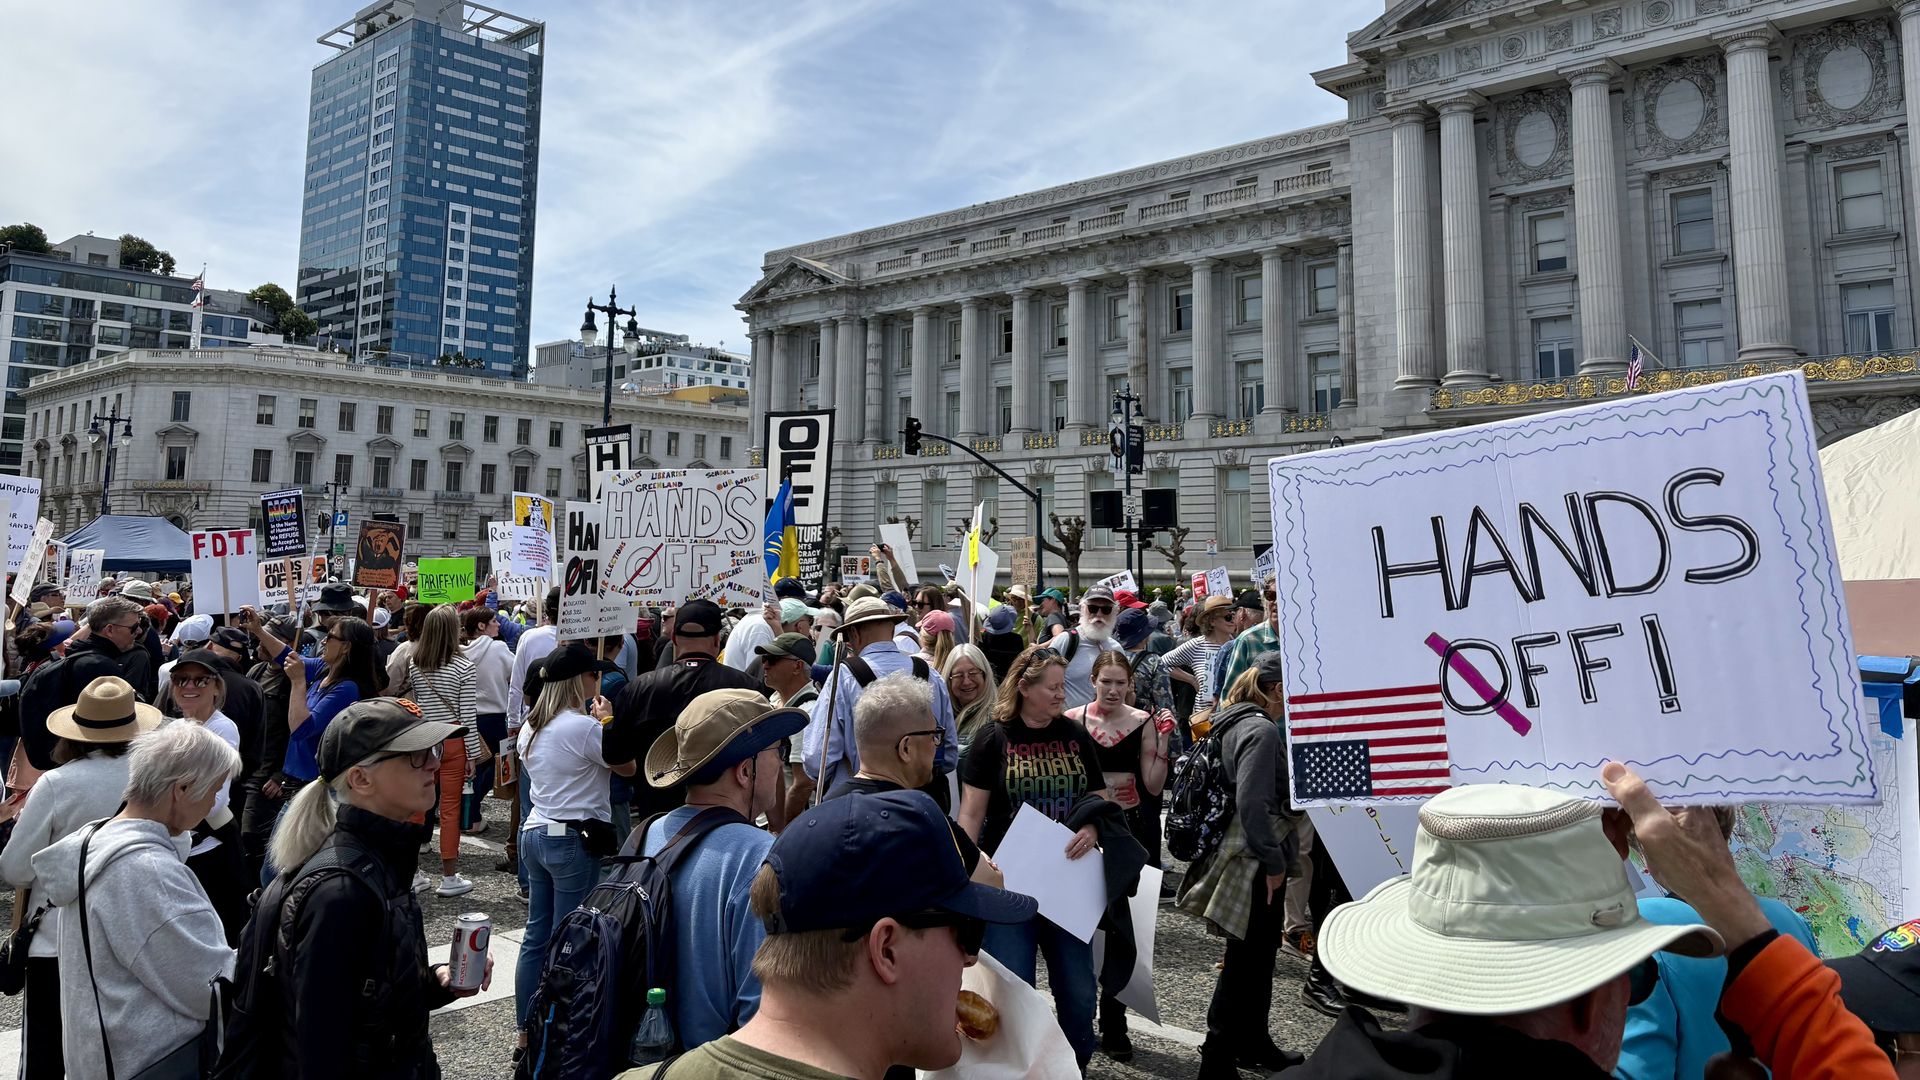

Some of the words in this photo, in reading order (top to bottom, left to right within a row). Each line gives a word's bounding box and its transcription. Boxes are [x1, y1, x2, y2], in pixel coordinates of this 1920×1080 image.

[618, 470, 642, 486] WALLET
[651, 470, 687, 480] LIBRARIES
[635, 481, 683, 492] GREENLAND
[716, 478, 734, 491] OUR
[267, 497, 297, 523] NO!
[604, 485, 757, 546] HANDS
[1127, 506, 1136, 515] 20
[278, 531, 300, 540] REFUSE
[795, 524, 823, 543] TURE
[192, 530, 252, 560] F.D.T.
[1371, 467, 1761, 618] HANDS
[79, 553, 95, 563] LET
[730, 549, 756, 558] SOCIAL
[797, 549, 821, 557] CRACY
[604, 541, 627, 579] ELECTIONS
[730, 555, 762, 567] SECURITY
[70, 563, 95, 575] THEM
[624, 544, 717, 590] OFF
[800, 564, 821, 573] URITY
[76, 575, 91, 585] EAT
[712, 566, 744, 585] MEDICARE
[69, 584, 98, 598] TESLAS
[265, 590, 276, 598] Our
[634, 587, 663, 596] ENERGY
[726, 581, 760, 599] MEDICAID
[727, 601, 755, 609] CANADA
[1438, 612, 1682, 716] OFF!
[1006, 741, 1082, 760] KAMALA
[1005, 753, 1087, 780] KAMALA
[1006, 774, 1089, 800] KAMALA
